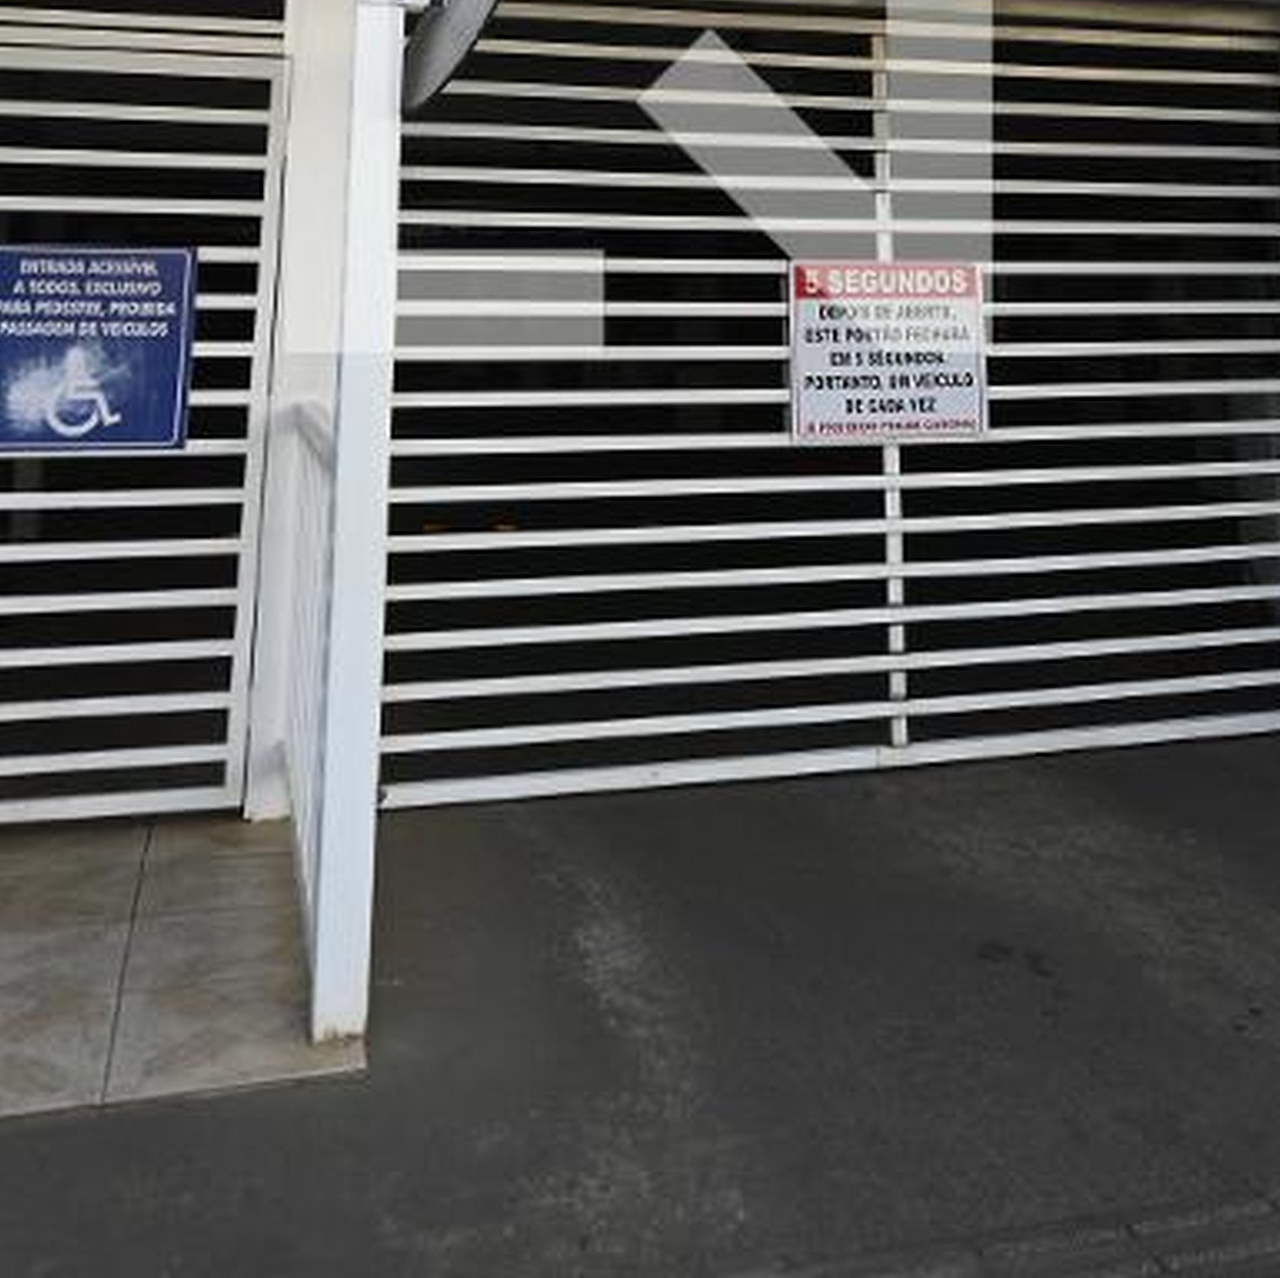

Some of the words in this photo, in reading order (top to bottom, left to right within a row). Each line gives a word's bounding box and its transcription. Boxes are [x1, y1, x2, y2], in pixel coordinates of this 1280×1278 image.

[19, 258, 86, 275] ENTRADA
[13, 282, 26, 294] A
[85, 281, 162, 296] EXCLUSIVO
[805, 269, 822, 294] 5
[827, 268, 968, 294] SEGUNDOS
[873, 305, 894, 320] DE
[0, 322, 76, 336] PASSAGEM
[78, 322, 98, 336] DE
[804, 326, 840, 343] ESTE
[829, 352, 853, 367] EM
[855, 352, 864, 367] 5
[845, 398, 864, 414] DE
[868, 398, 906, 414] CADA
[908, 397, 938, 413] VEZ
